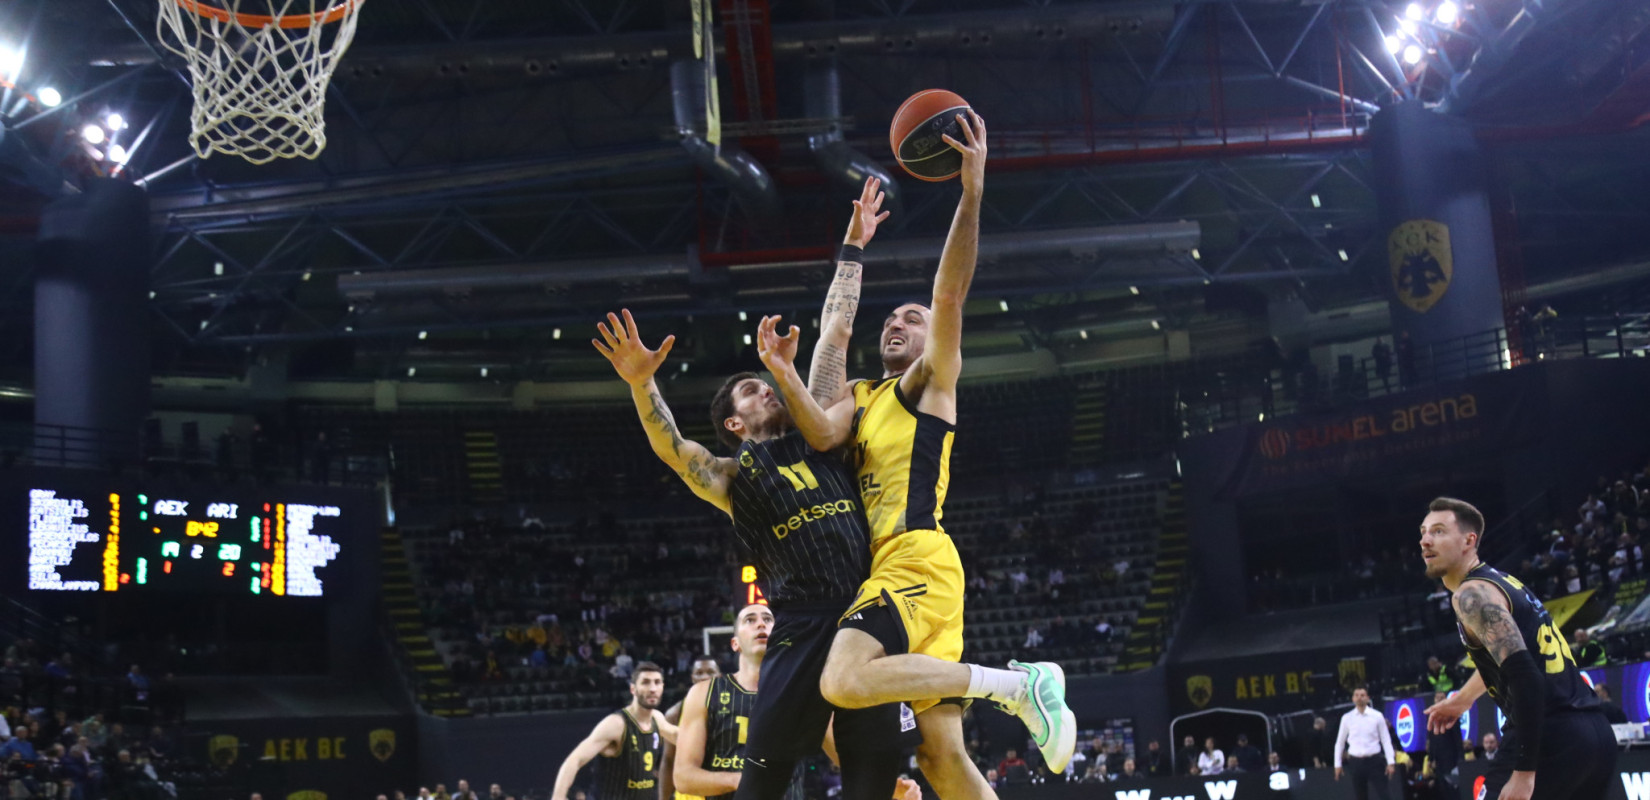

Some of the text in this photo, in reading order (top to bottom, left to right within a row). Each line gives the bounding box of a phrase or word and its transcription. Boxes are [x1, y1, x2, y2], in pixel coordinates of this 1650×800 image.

[1295, 393, 1478, 451] SUNEL arena
[777, 460, 819, 492] 11
[154, 500, 190, 516] AEK
[206, 503, 239, 519] ARI
[191, 544, 203, 559] 2
[222, 562, 235, 576] 2
[1236, 671, 1315, 699] AEK BC
[264, 737, 346, 761] AEK BC
[644, 752, 653, 771] 9
